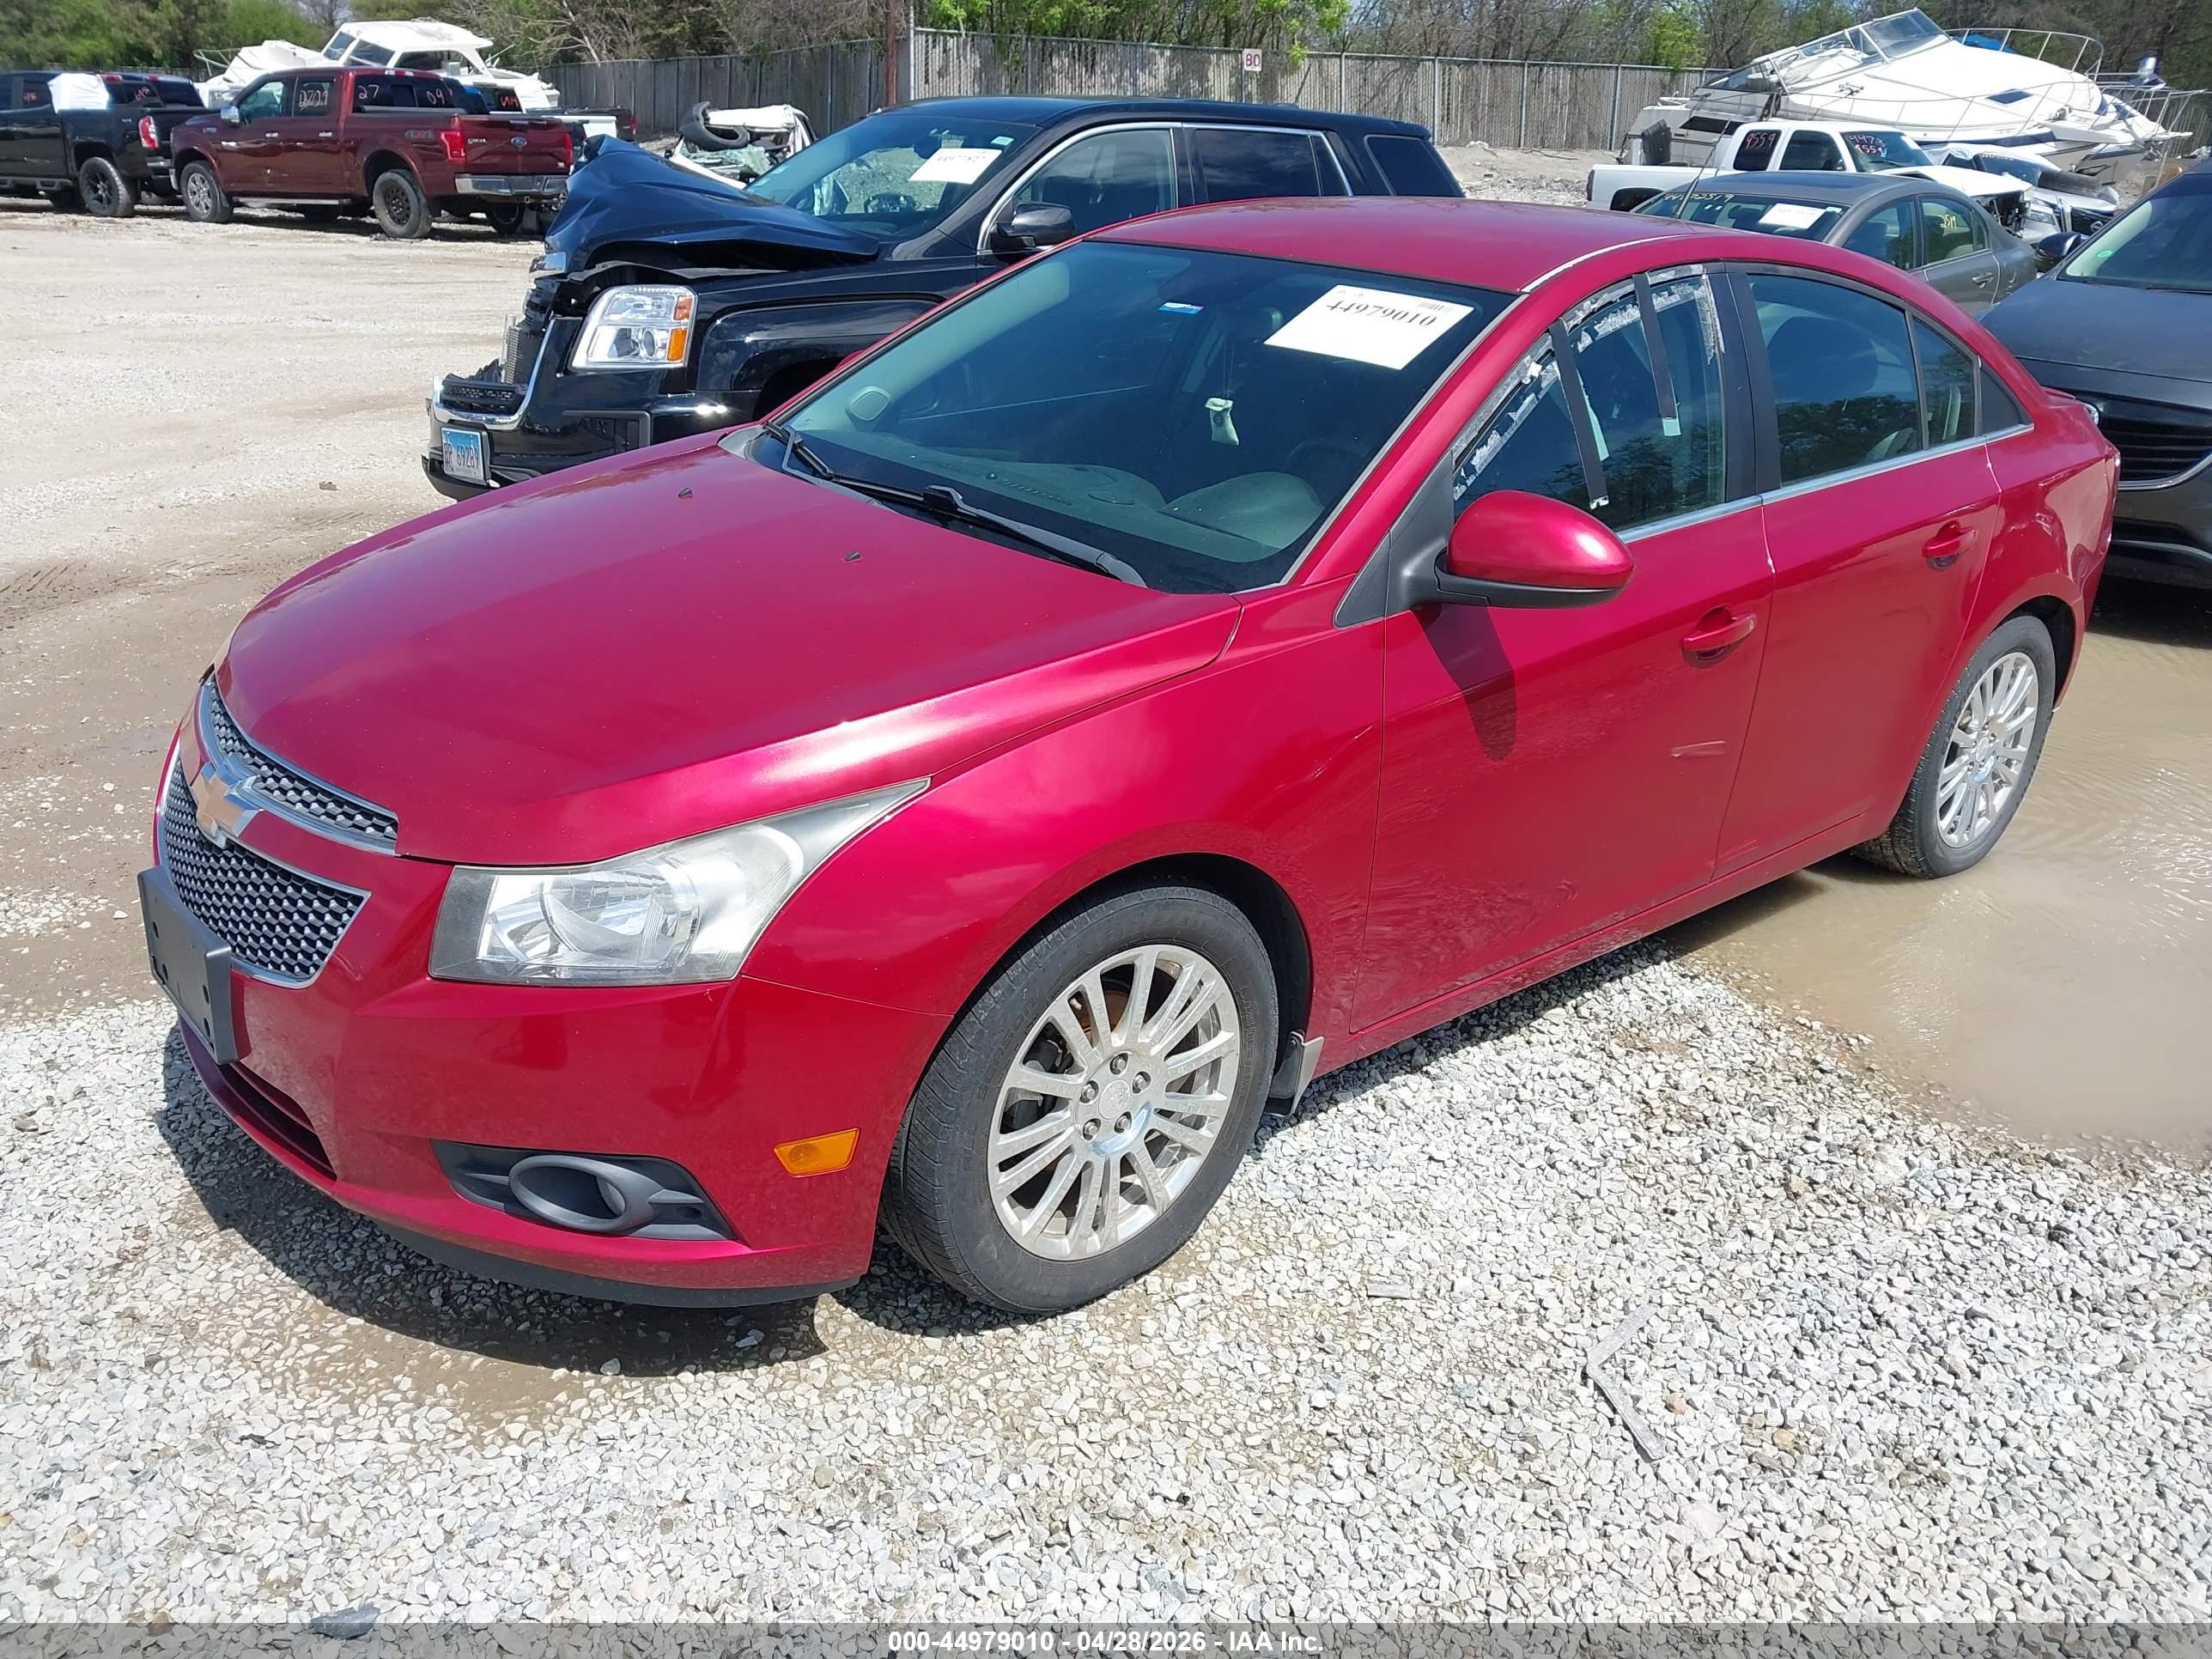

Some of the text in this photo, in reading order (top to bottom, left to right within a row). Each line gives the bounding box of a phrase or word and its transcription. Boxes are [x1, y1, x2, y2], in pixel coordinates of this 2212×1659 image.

[1245, 53, 1261, 67] 80
[358, 84, 380, 100] 27
[1326, 300, 1437, 327] 44979010
